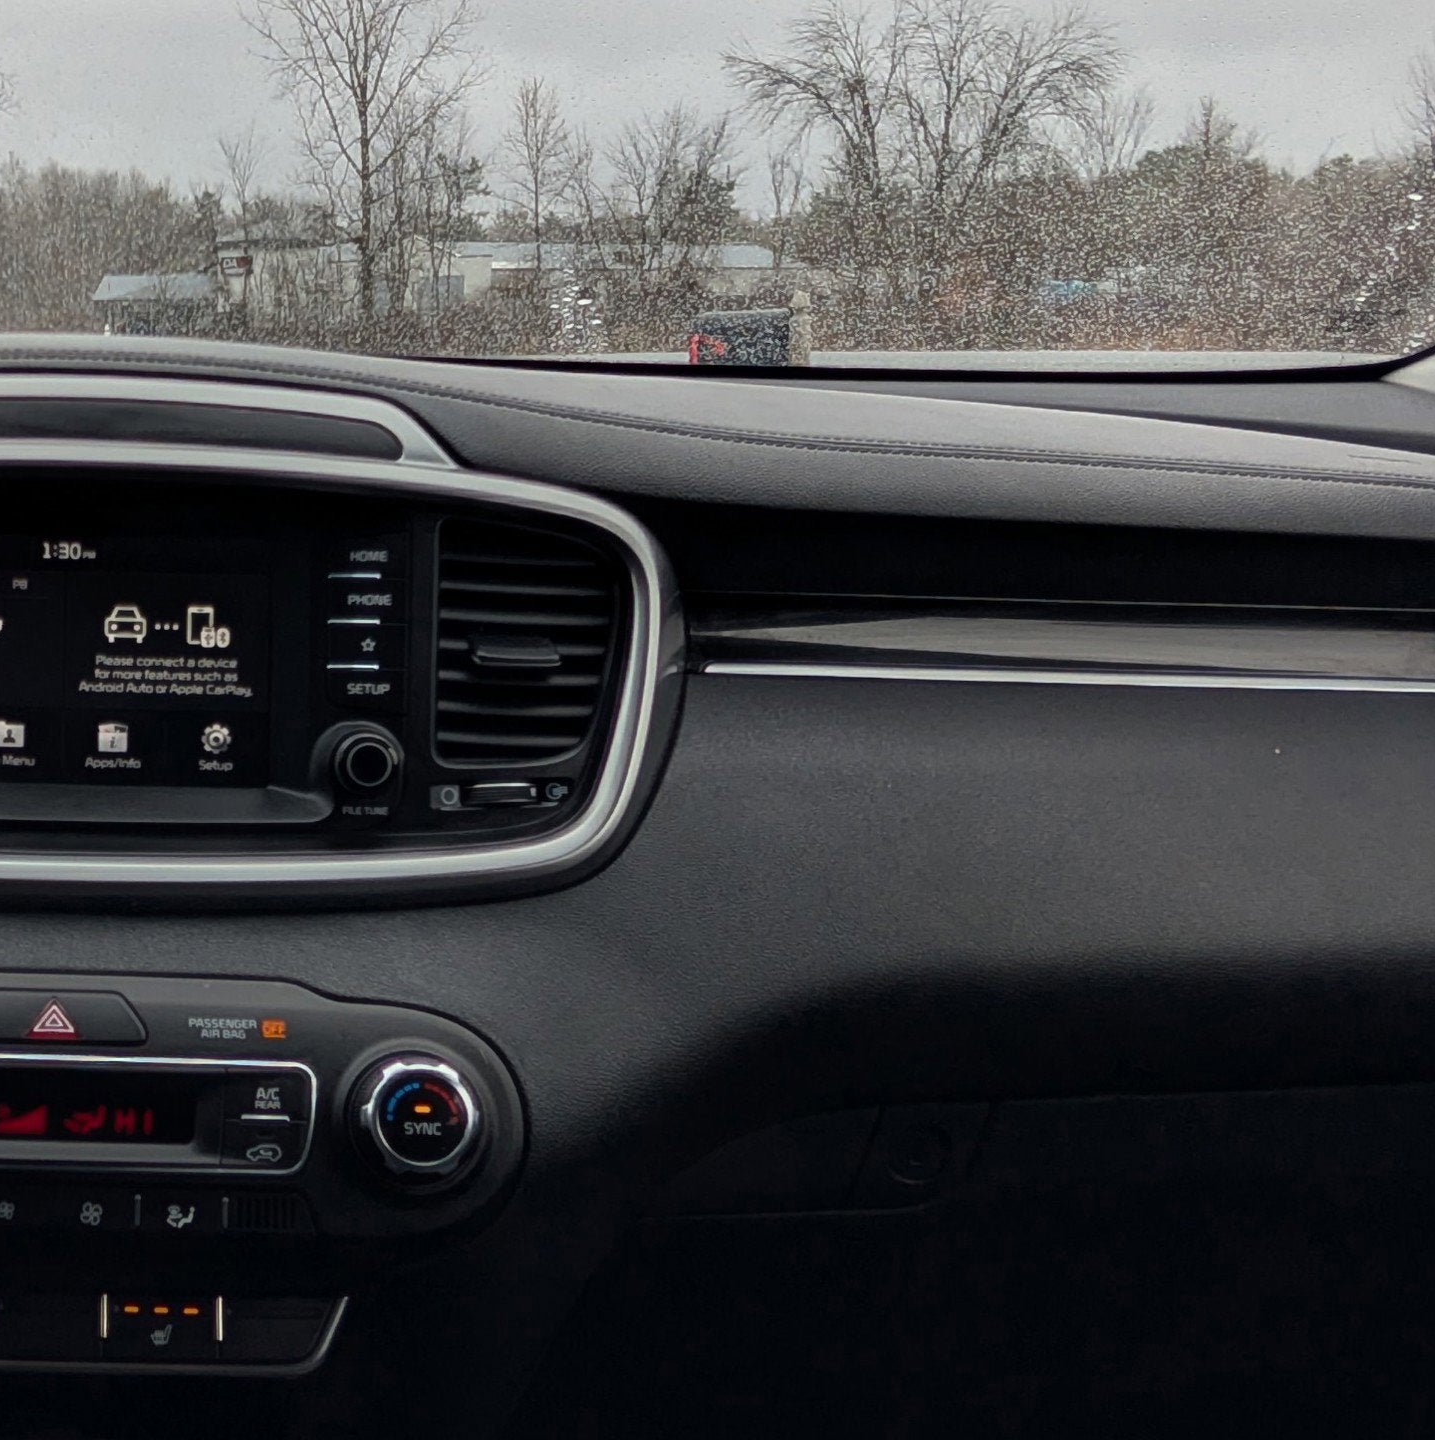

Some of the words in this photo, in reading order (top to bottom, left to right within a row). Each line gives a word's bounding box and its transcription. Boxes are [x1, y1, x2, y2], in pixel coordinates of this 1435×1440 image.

[42, 541, 82, 559] 1:30
[350, 550, 389, 562] HOME
[347, 593, 393, 607] PHONE
[95, 654, 134, 667] Please
[136, 656, 185, 668] connect
[187, 658, 196, 668] a
[197, 657, 238, 669] device
[94, 667, 110, 680] for
[112, 669, 143, 680] more
[144, 669, 192, 681] features
[193, 670, 222, 682] such
[224, 672, 238, 682] as
[78, 680, 124, 693] Android
[125, 681, 154, 695] Auto
[155, 684, 168, 695] or
[169, 682, 204, 696] Apple
[346, 683, 391, 696] SETUP
[1, 754, 36, 767] Menu
[84, 756, 142, 770] Apps/Info
[198, 759, 233, 772] Setup
[188, 1018, 257, 1029] PASSENGER
[201, 1029, 220, 1039] AIR
[222, 1029, 247, 1040] BAG
[255, 1087, 280, 1101] A/C
[253, 1100, 281, 1110] REAR
[403, 1121, 442, 1136] SYNC
